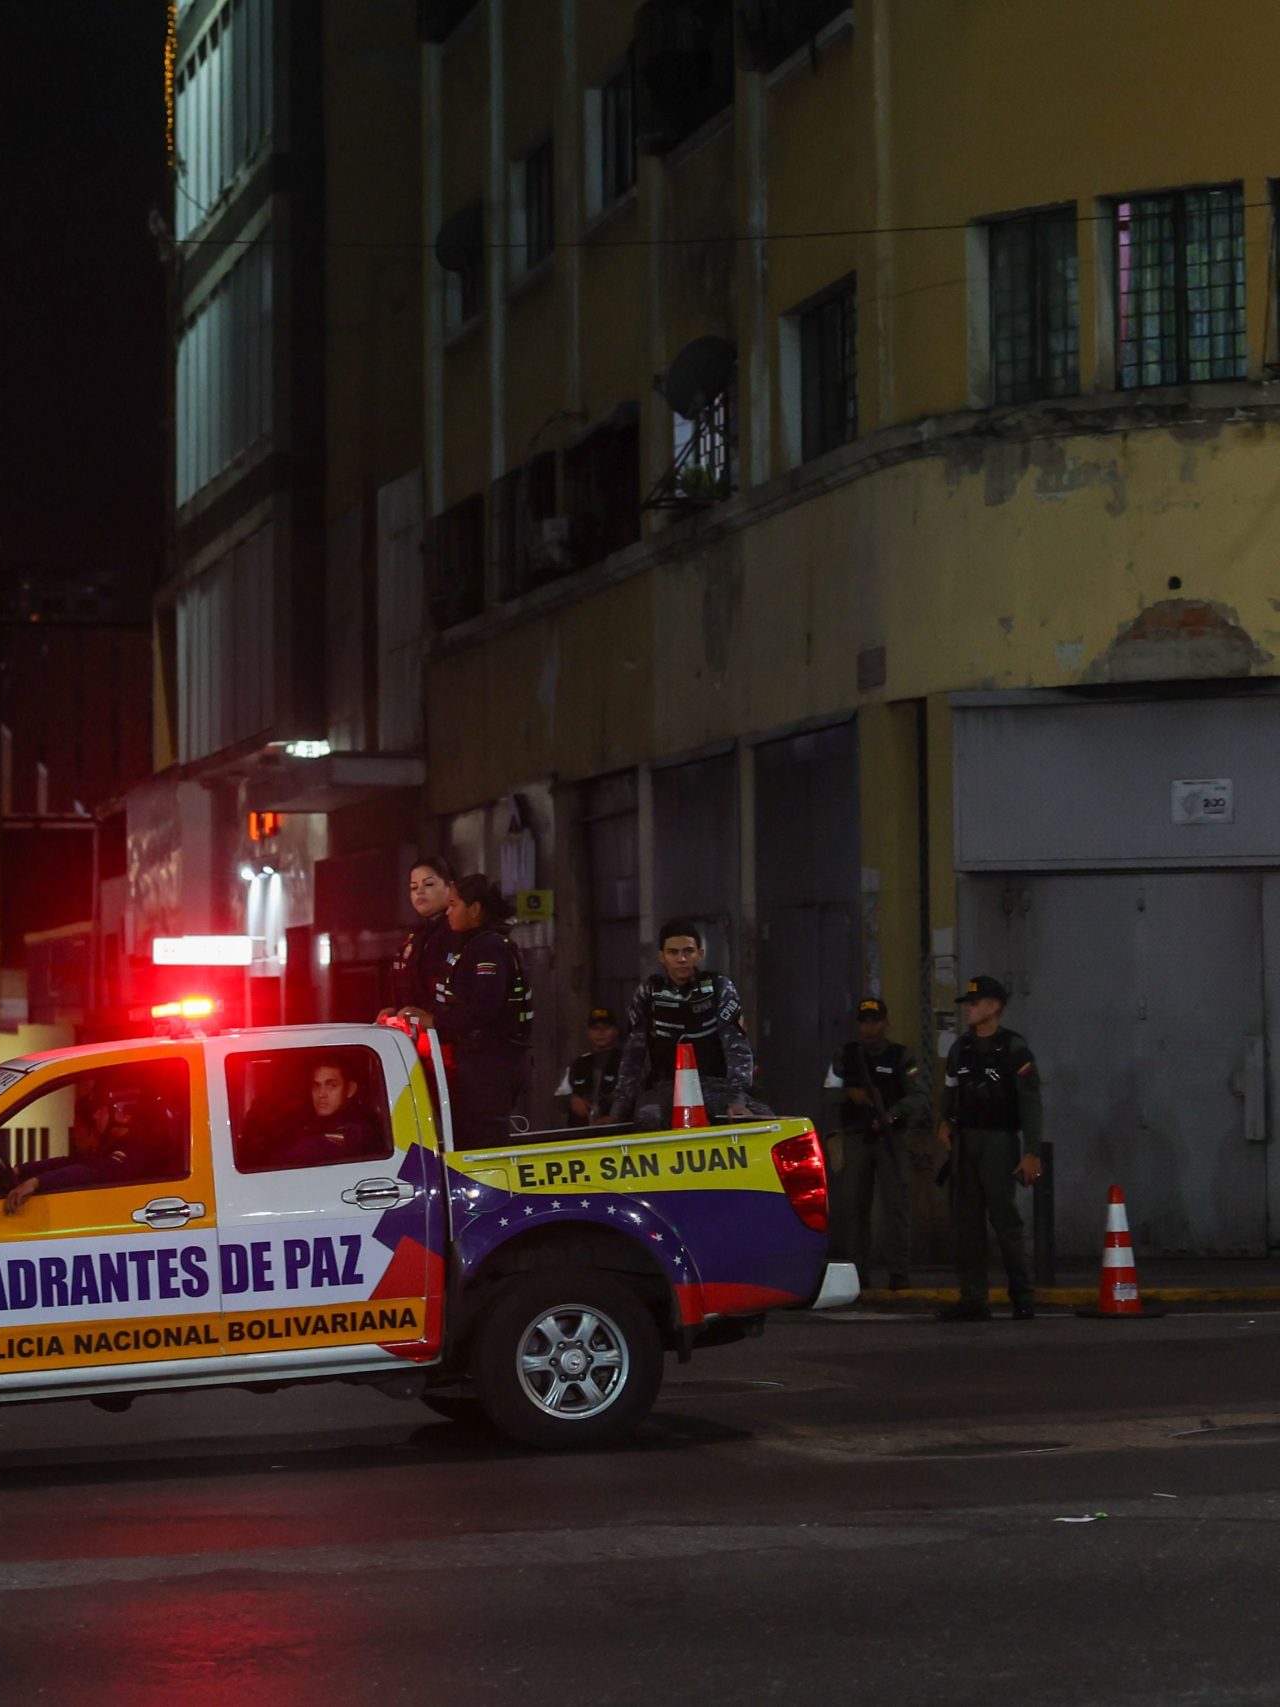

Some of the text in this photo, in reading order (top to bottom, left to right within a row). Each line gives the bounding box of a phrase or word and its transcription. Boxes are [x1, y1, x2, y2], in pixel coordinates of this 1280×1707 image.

[517, 1145, 748, 1187] E.P.P. SAN JUAN
[220, 1241, 275, 1294] DE
[283, 1234, 364, 1289] PAZ
[74, 1324, 219, 1354] NACIONAL
[228, 1308, 418, 1342] BOLIVARIANA
